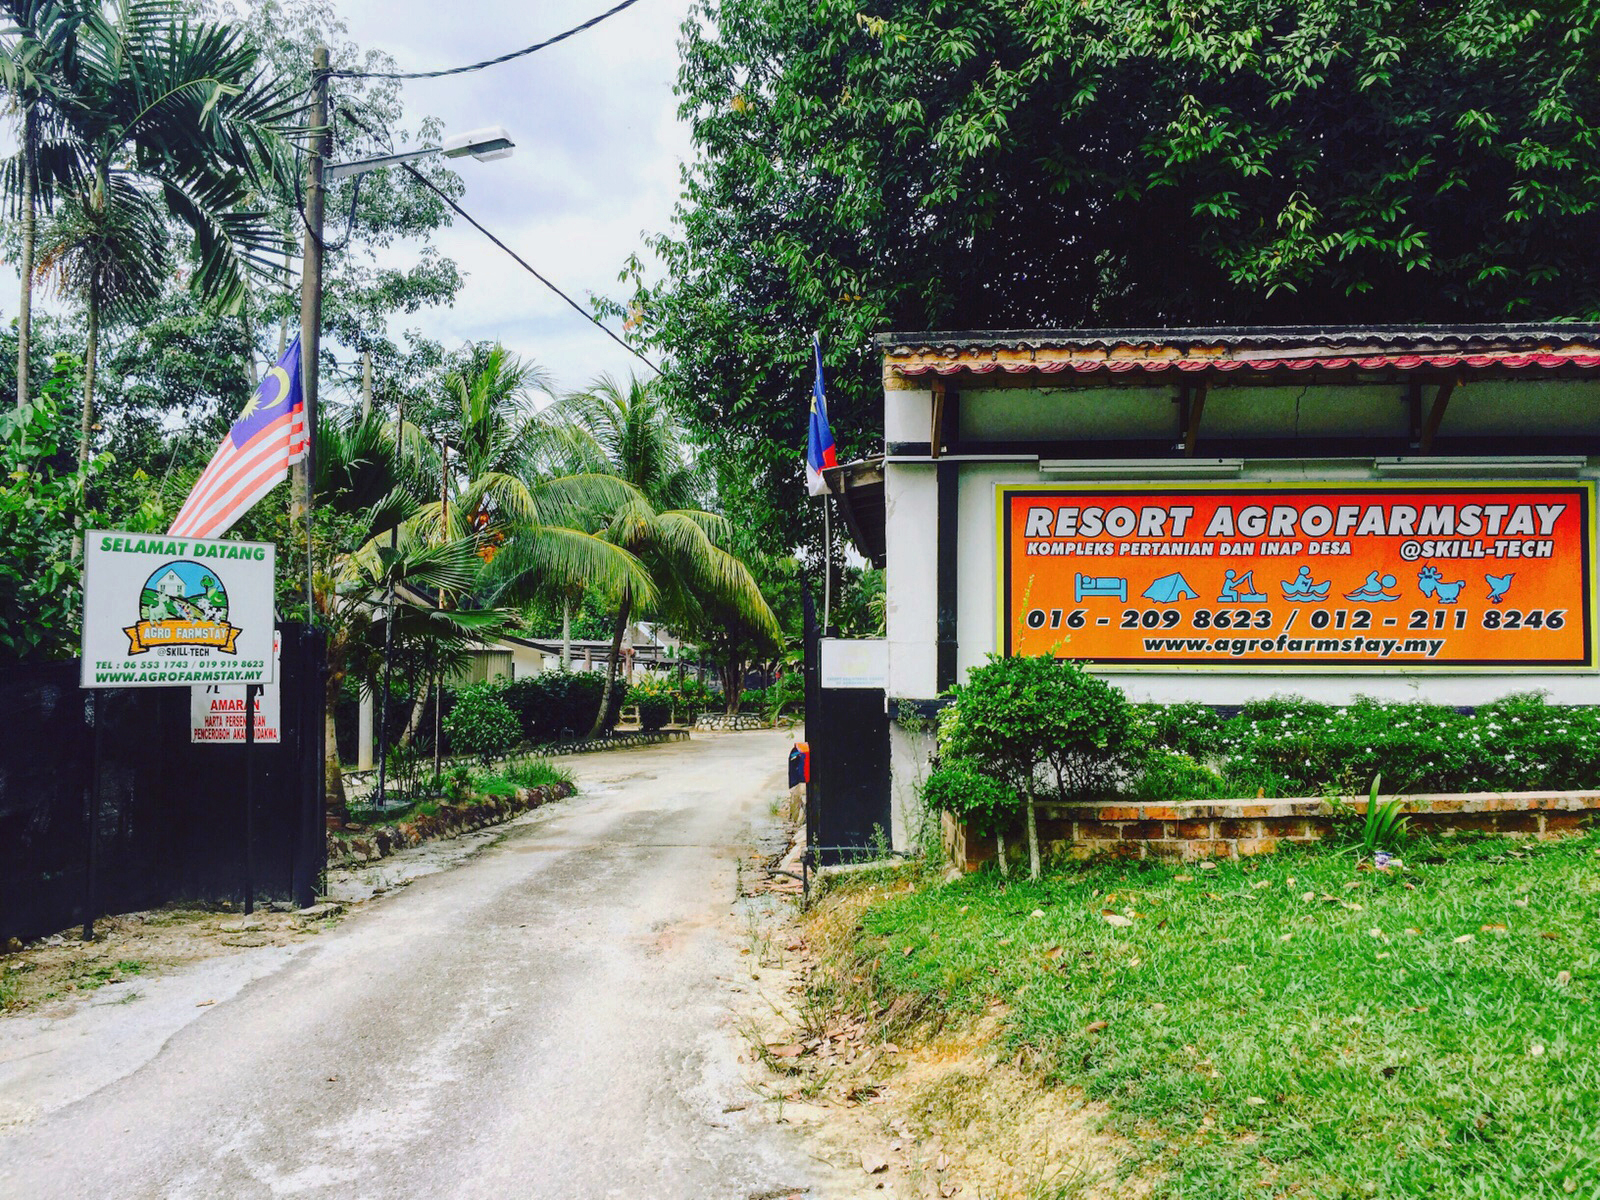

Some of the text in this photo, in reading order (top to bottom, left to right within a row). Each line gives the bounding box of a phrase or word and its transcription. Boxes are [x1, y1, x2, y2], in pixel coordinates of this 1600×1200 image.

[1024, 504, 1567, 538] RESORT AGROFARMSTAY
[100, 537, 265, 561] SELAMAT DATANG
[1027, 541, 1352, 556] KOMPLEKS PERTANIAN DAN INAP DESA
[1400, 540, 1554, 561] @SKILL-TECH
[1027, 608, 1089, 629] 016
[1120, 608, 1181, 629] 209
[1192, 608, 1272, 629] 8623
[1310, 608, 1372, 630] 012
[1408, 608, 1467, 630] 211
[1482, 608, 1568, 630] 8246
[144, 627, 227, 639] AGRO FARMSTAY
[157, 647, 210, 657] @SKILL-TECH
[1143, 635, 1446, 658] www.agrofarmstay.my
[95, 661, 113, 669] TEL
[123, 661, 136, 669] 06
[140, 661, 159, 669] 553
[164, 661, 188, 669] 1743
[240, 660, 264, 668] 8623
[95, 671, 263, 683] WWW.AGROFARMSTAY.MY
[204, 716, 223, 727] HARTA
